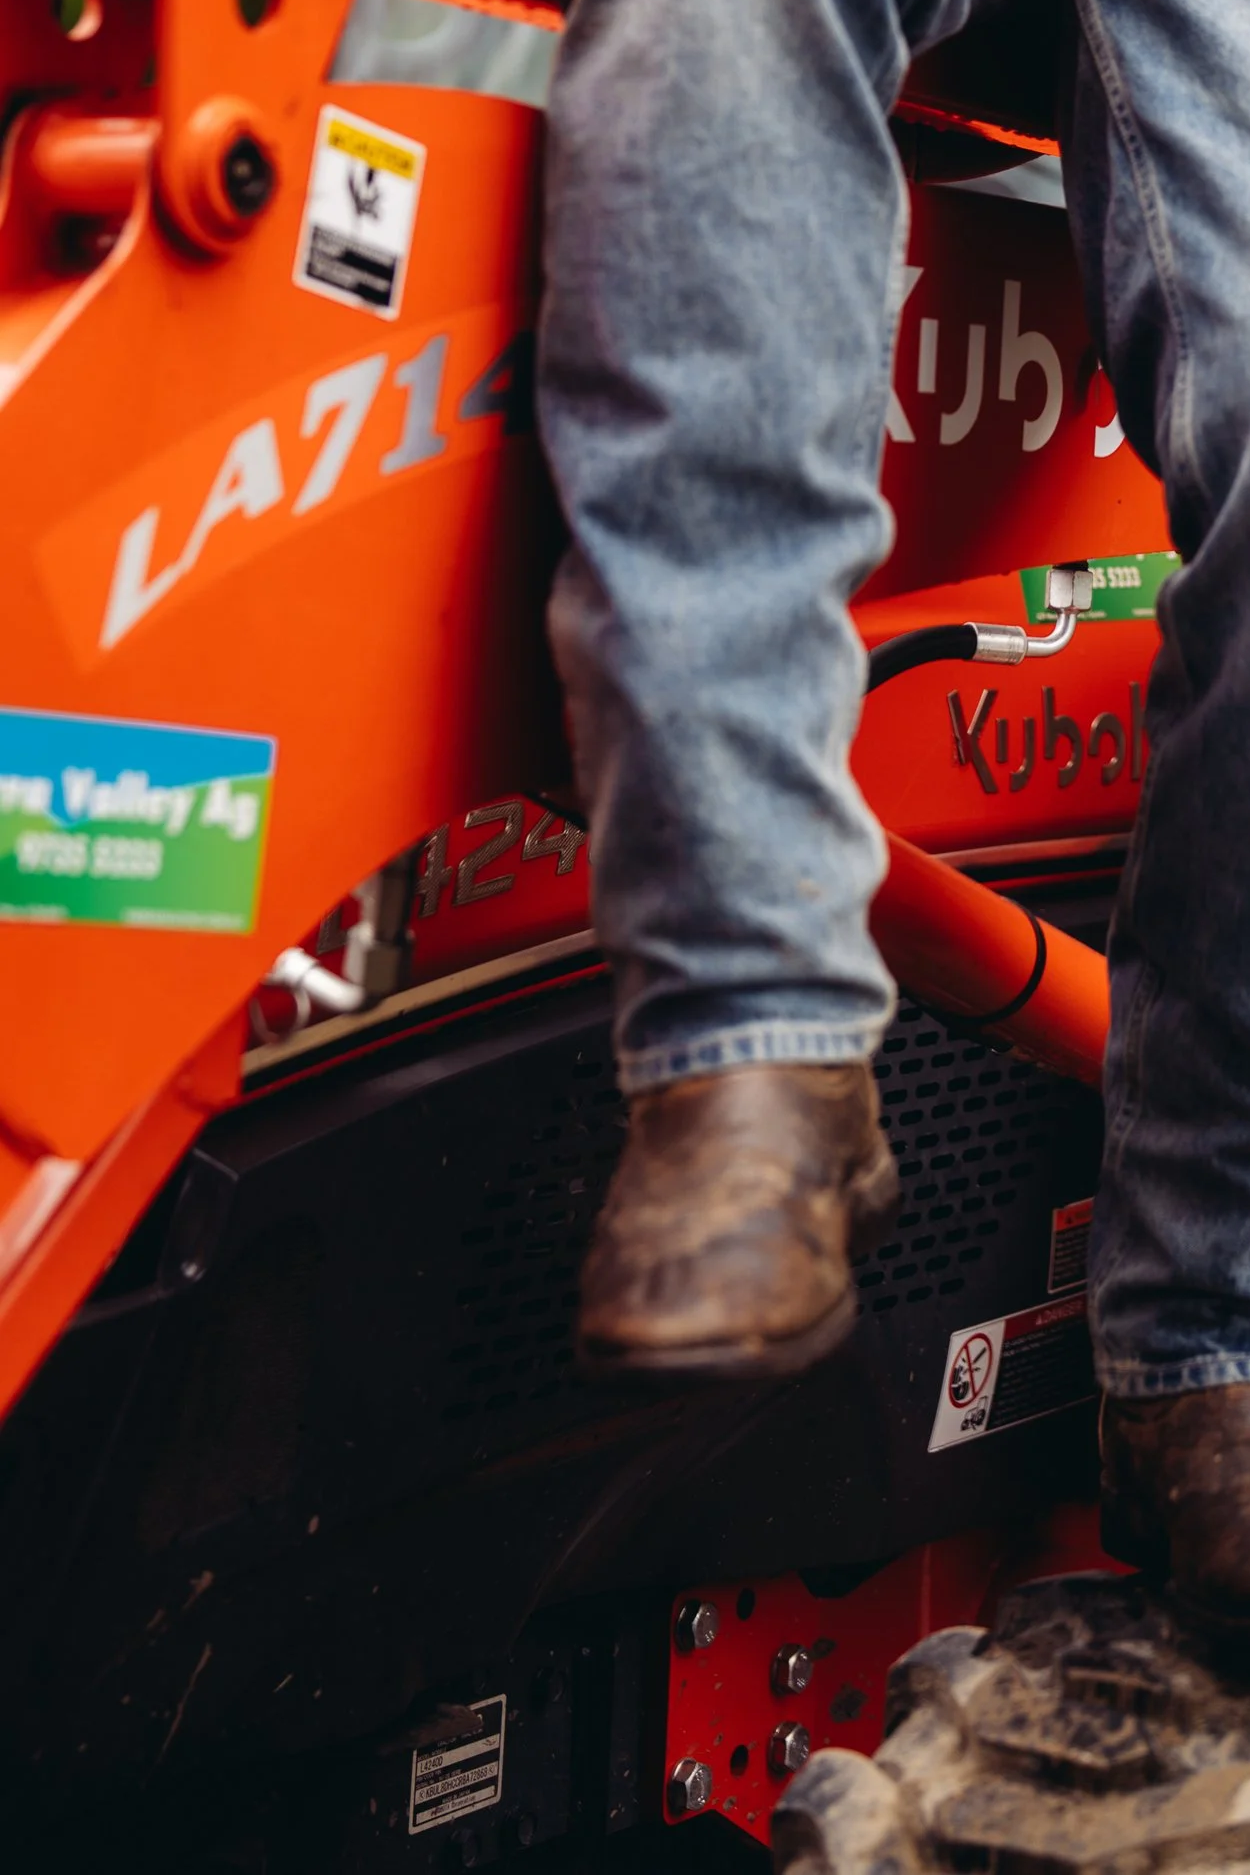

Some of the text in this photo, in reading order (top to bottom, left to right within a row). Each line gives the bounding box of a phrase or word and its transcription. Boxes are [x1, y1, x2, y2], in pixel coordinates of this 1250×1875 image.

[99, 331, 535, 651] LA714
[62, 765, 195, 837] Valley
[199, 778, 260, 841] Ag
[317, 799, 591, 955] 424
